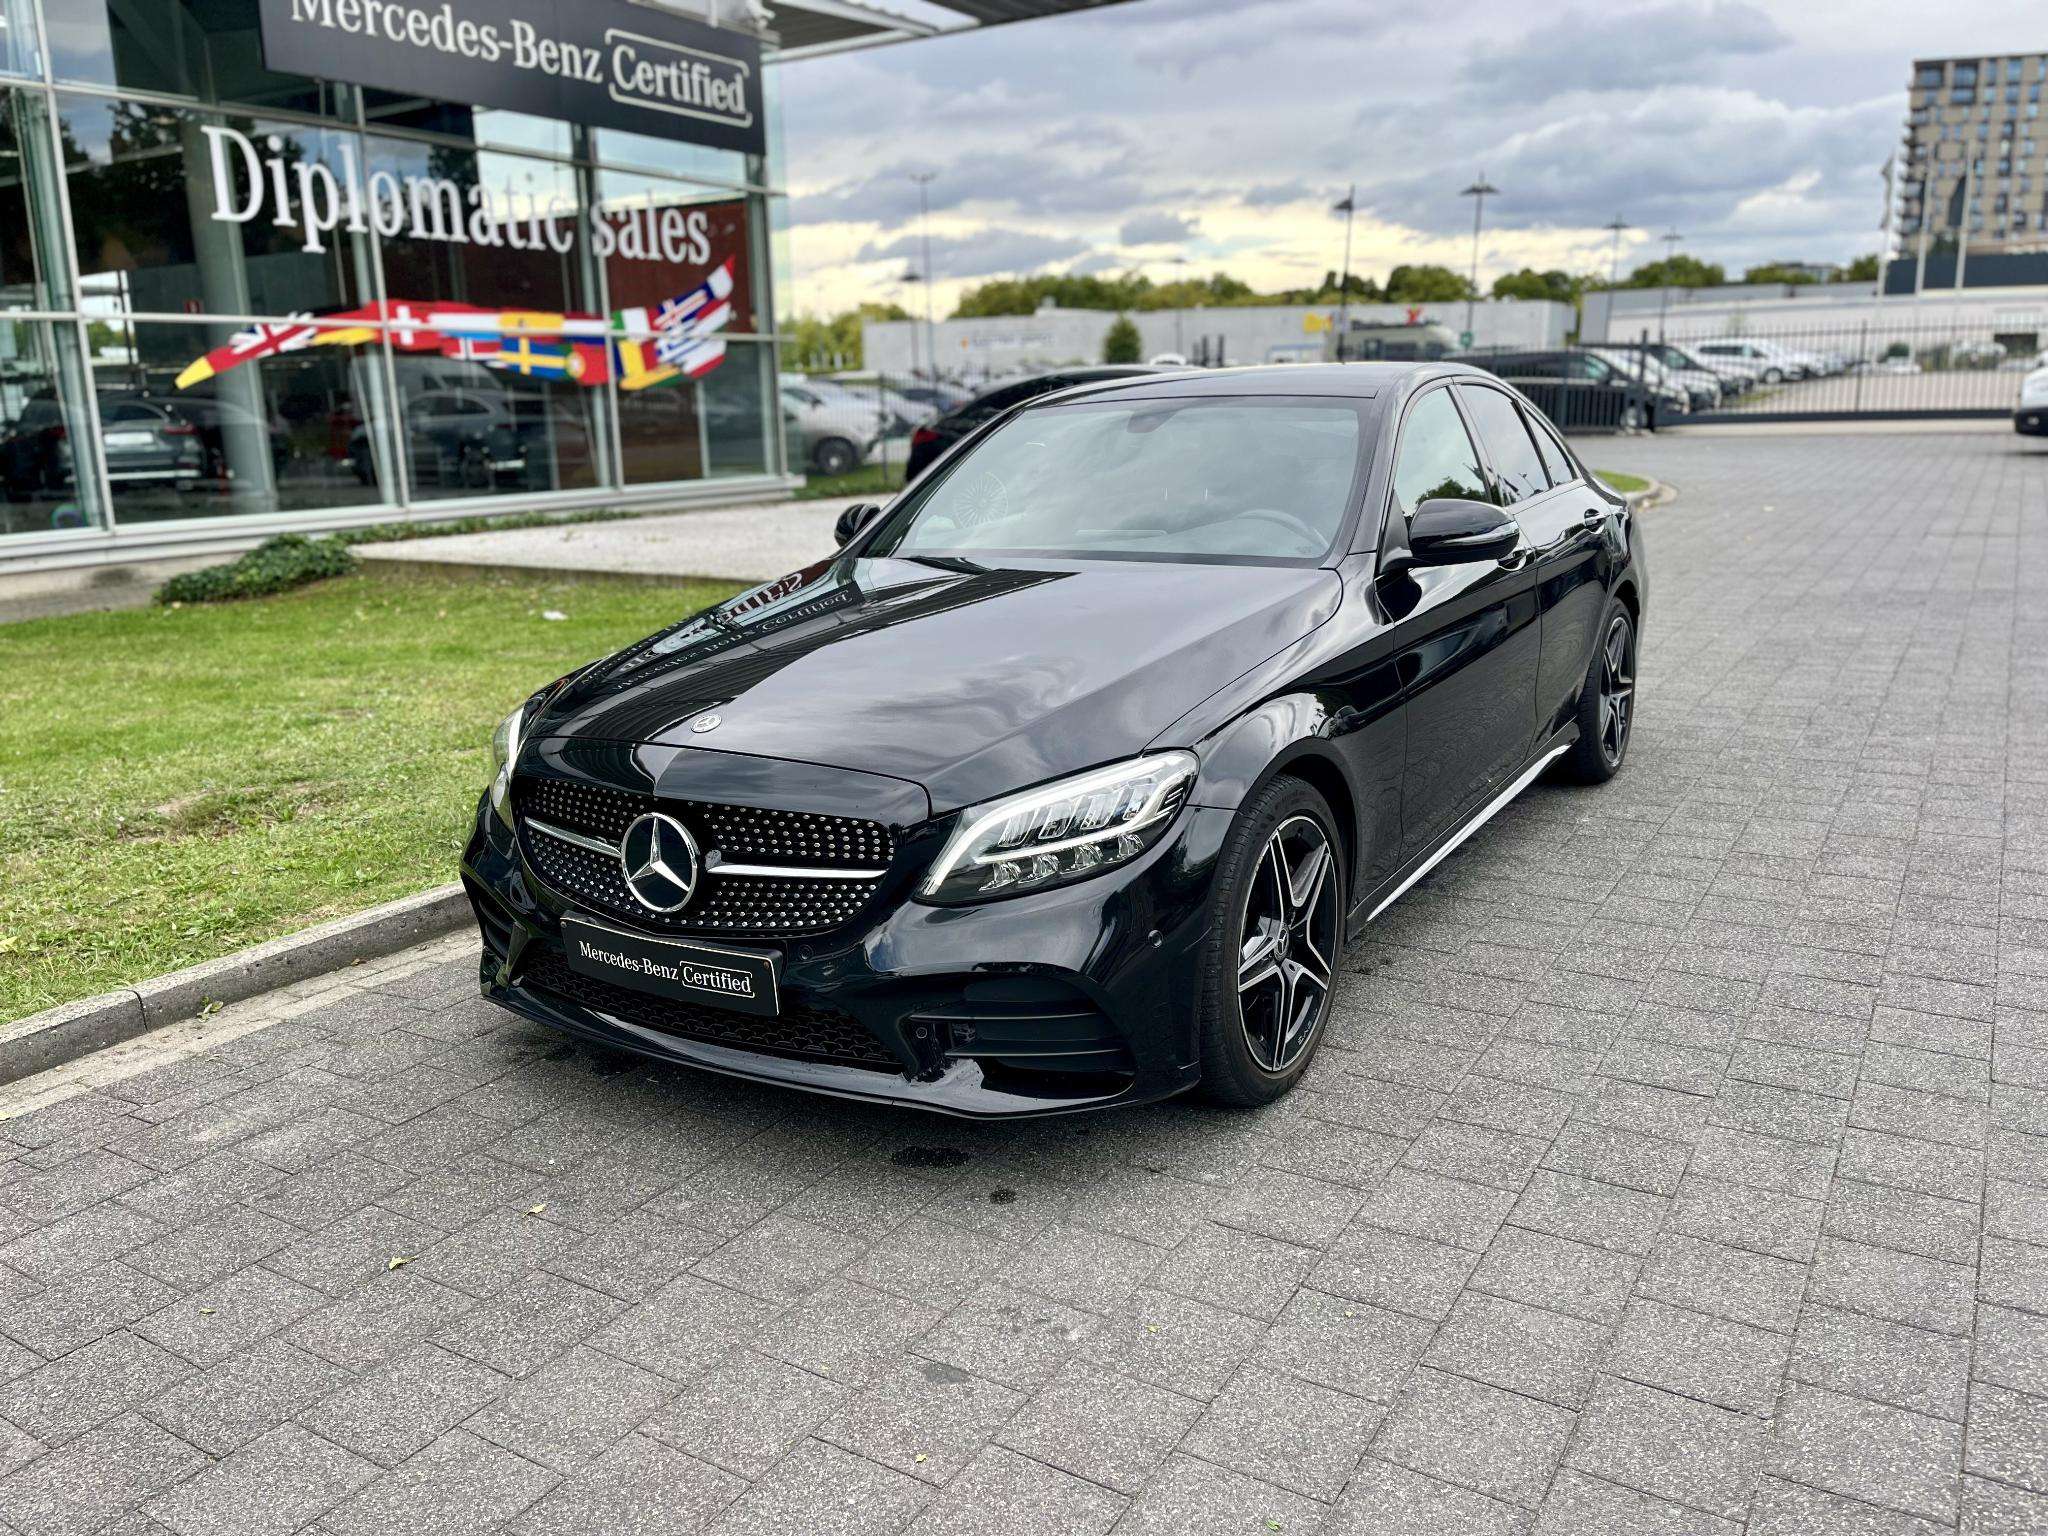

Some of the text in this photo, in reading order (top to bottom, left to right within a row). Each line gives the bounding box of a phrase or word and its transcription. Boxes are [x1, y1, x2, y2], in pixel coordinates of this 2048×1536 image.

[612, 44, 746, 114] Certified
[201, 126, 712, 265] Diplomatic sales
[578, 940, 752, 993] Mercedes-Benz Certified
